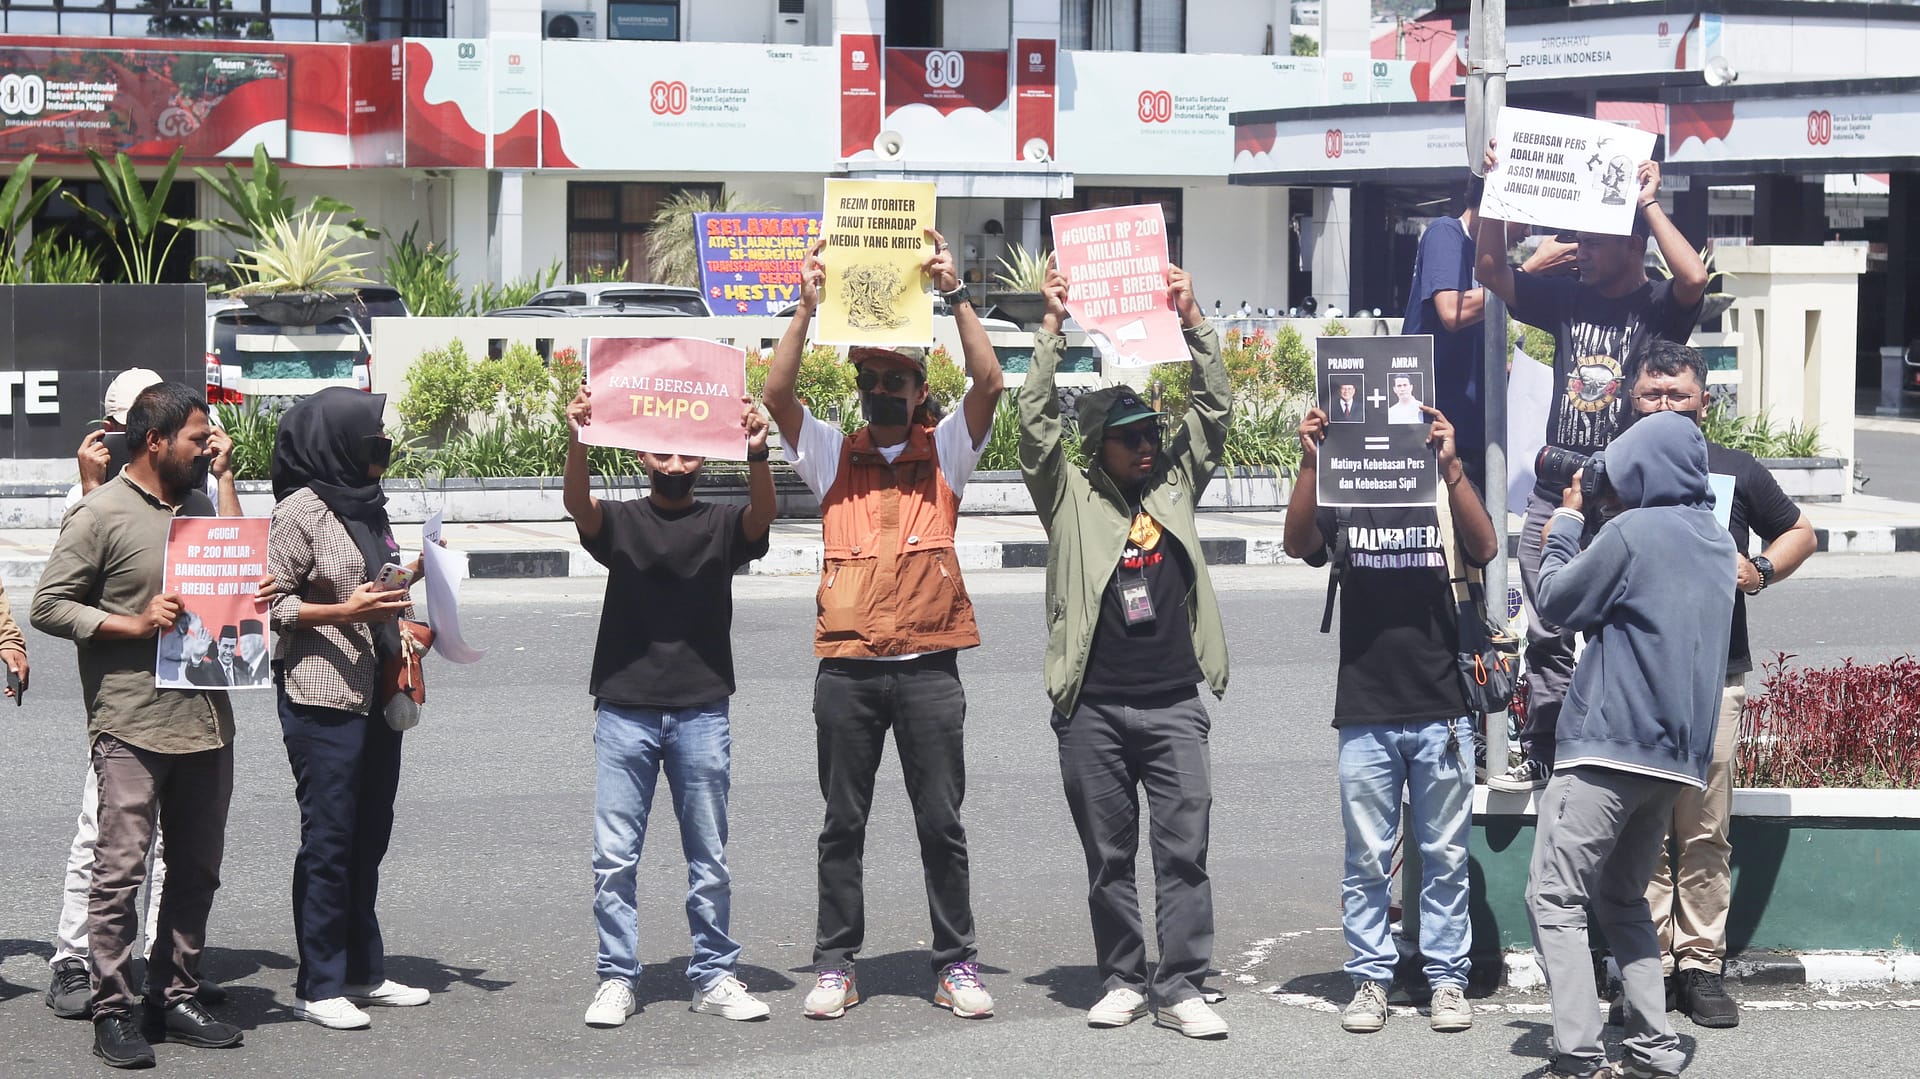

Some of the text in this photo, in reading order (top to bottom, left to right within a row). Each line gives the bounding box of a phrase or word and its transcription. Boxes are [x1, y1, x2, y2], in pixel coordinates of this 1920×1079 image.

[1542, 36, 1590, 49] DIRGAHAYU
[1520, 51, 1612, 66] REPUBLIK INDONESIA
[925, 50, 964, 88] 80
[46, 81, 78, 90] Bersatu
[690, 86, 716, 94] Bersatu
[0, 74, 44, 115] 80
[46, 91, 74, 101] Rakyat
[650, 80, 688, 115] 80
[690, 95, 747, 104] Rakyat Sejahtera
[46, 101, 105, 113] Indonesia Maju
[1138, 90, 1172, 123] 80
[1197, 104, 1226, 112] Sejahtera
[42, 120, 75, 128] REPUBLIK
[76, 121, 111, 129] INDONESIA
[1808, 110, 1832, 145] 80
[1513, 131, 1587, 150] KEBEBASAN PERS
[1510, 148, 1564, 165] ADALAH HAK
[1507, 165, 1534, 179] ASASI
[1504, 181, 1581, 201] JANGAN DIGUGAT!
[840, 198, 915, 212] REZIM OTORITER
[836, 216, 917, 231] TAKUT TERHADAP
[1061, 218, 1160, 246] #GUGAT RP 200
[709, 236, 736, 248] ATAS
[739, 236, 805, 249] LAUNCHING
[829, 234, 860, 247] MEDIA
[863, 235, 889, 249] YANG
[892, 236, 922, 250] KRITIS
[1086, 240, 1141, 262] MILIAR =
[707, 261, 780, 272] TRANSFORMASI
[1070, 256, 1160, 282] BANGKRUTKAN
[724, 284, 794, 300] HESTY
[1068, 274, 1167, 302] MEDIA = BREDEL
[1084, 294, 1157, 318] GAYA BARU.
[1328, 357, 1418, 370] PRABOWO AMRAN
[608, 376, 730, 398] KAMI BERSAMA
[629, 394, 710, 422] TEMPO
[1330, 457, 1425, 473] Matinya Kebebasan Pers
[1339, 476, 1417, 491] dan Kebebasan Sipil
[207, 528, 239, 540] #GUGAT
[188, 545, 200, 558] RP
[203, 545, 222, 558] 200
[223, 545, 250, 558] MILIAR
[175, 564, 263, 577] BANGKRUTKAN MEDIA
[181, 582, 215, 595] BREDEL
[218, 582, 239, 595] GAYA
